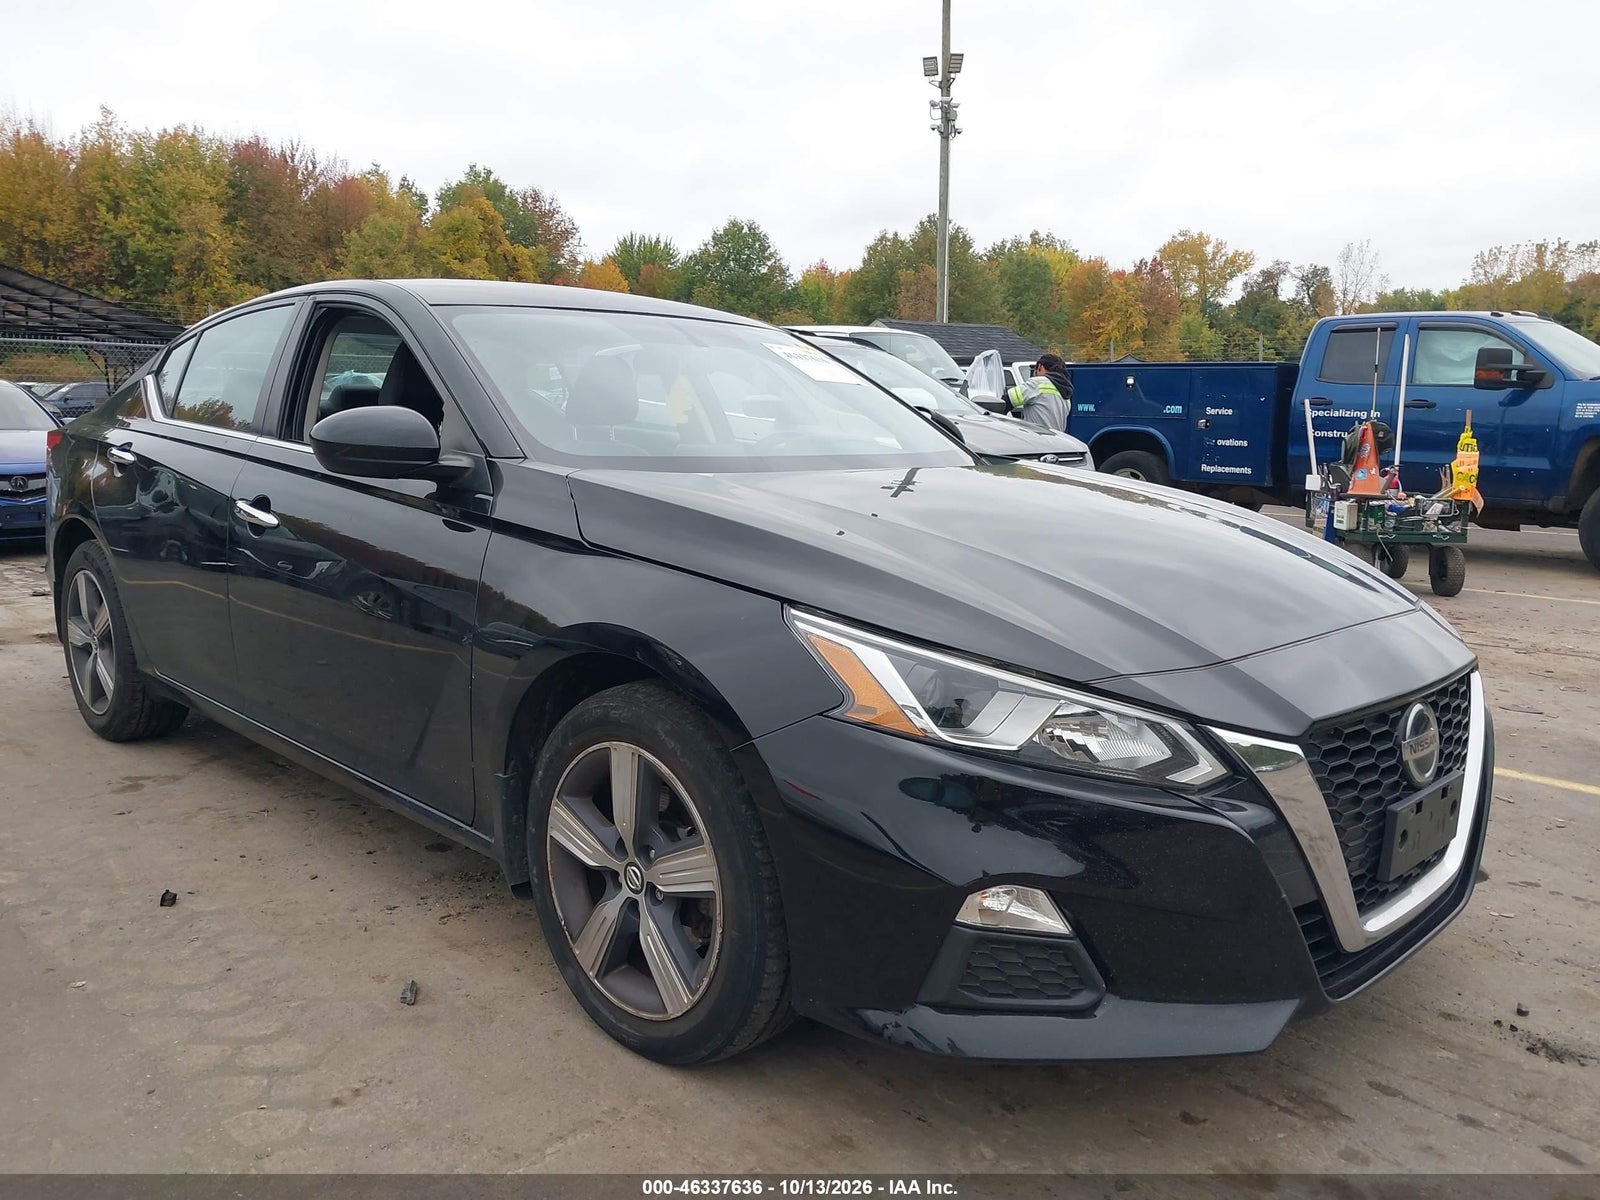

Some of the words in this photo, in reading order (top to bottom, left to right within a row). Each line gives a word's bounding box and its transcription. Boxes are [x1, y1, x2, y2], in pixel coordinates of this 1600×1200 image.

[1163, 405, 1183, 414] .com
[1205, 406, 1233, 415] Service
[1306, 408, 1368, 420] Specializing
[1370, 409, 1381, 418] In
[1201, 463, 1252, 475] Replacements
[1409, 733, 1437, 756] NISSAN
